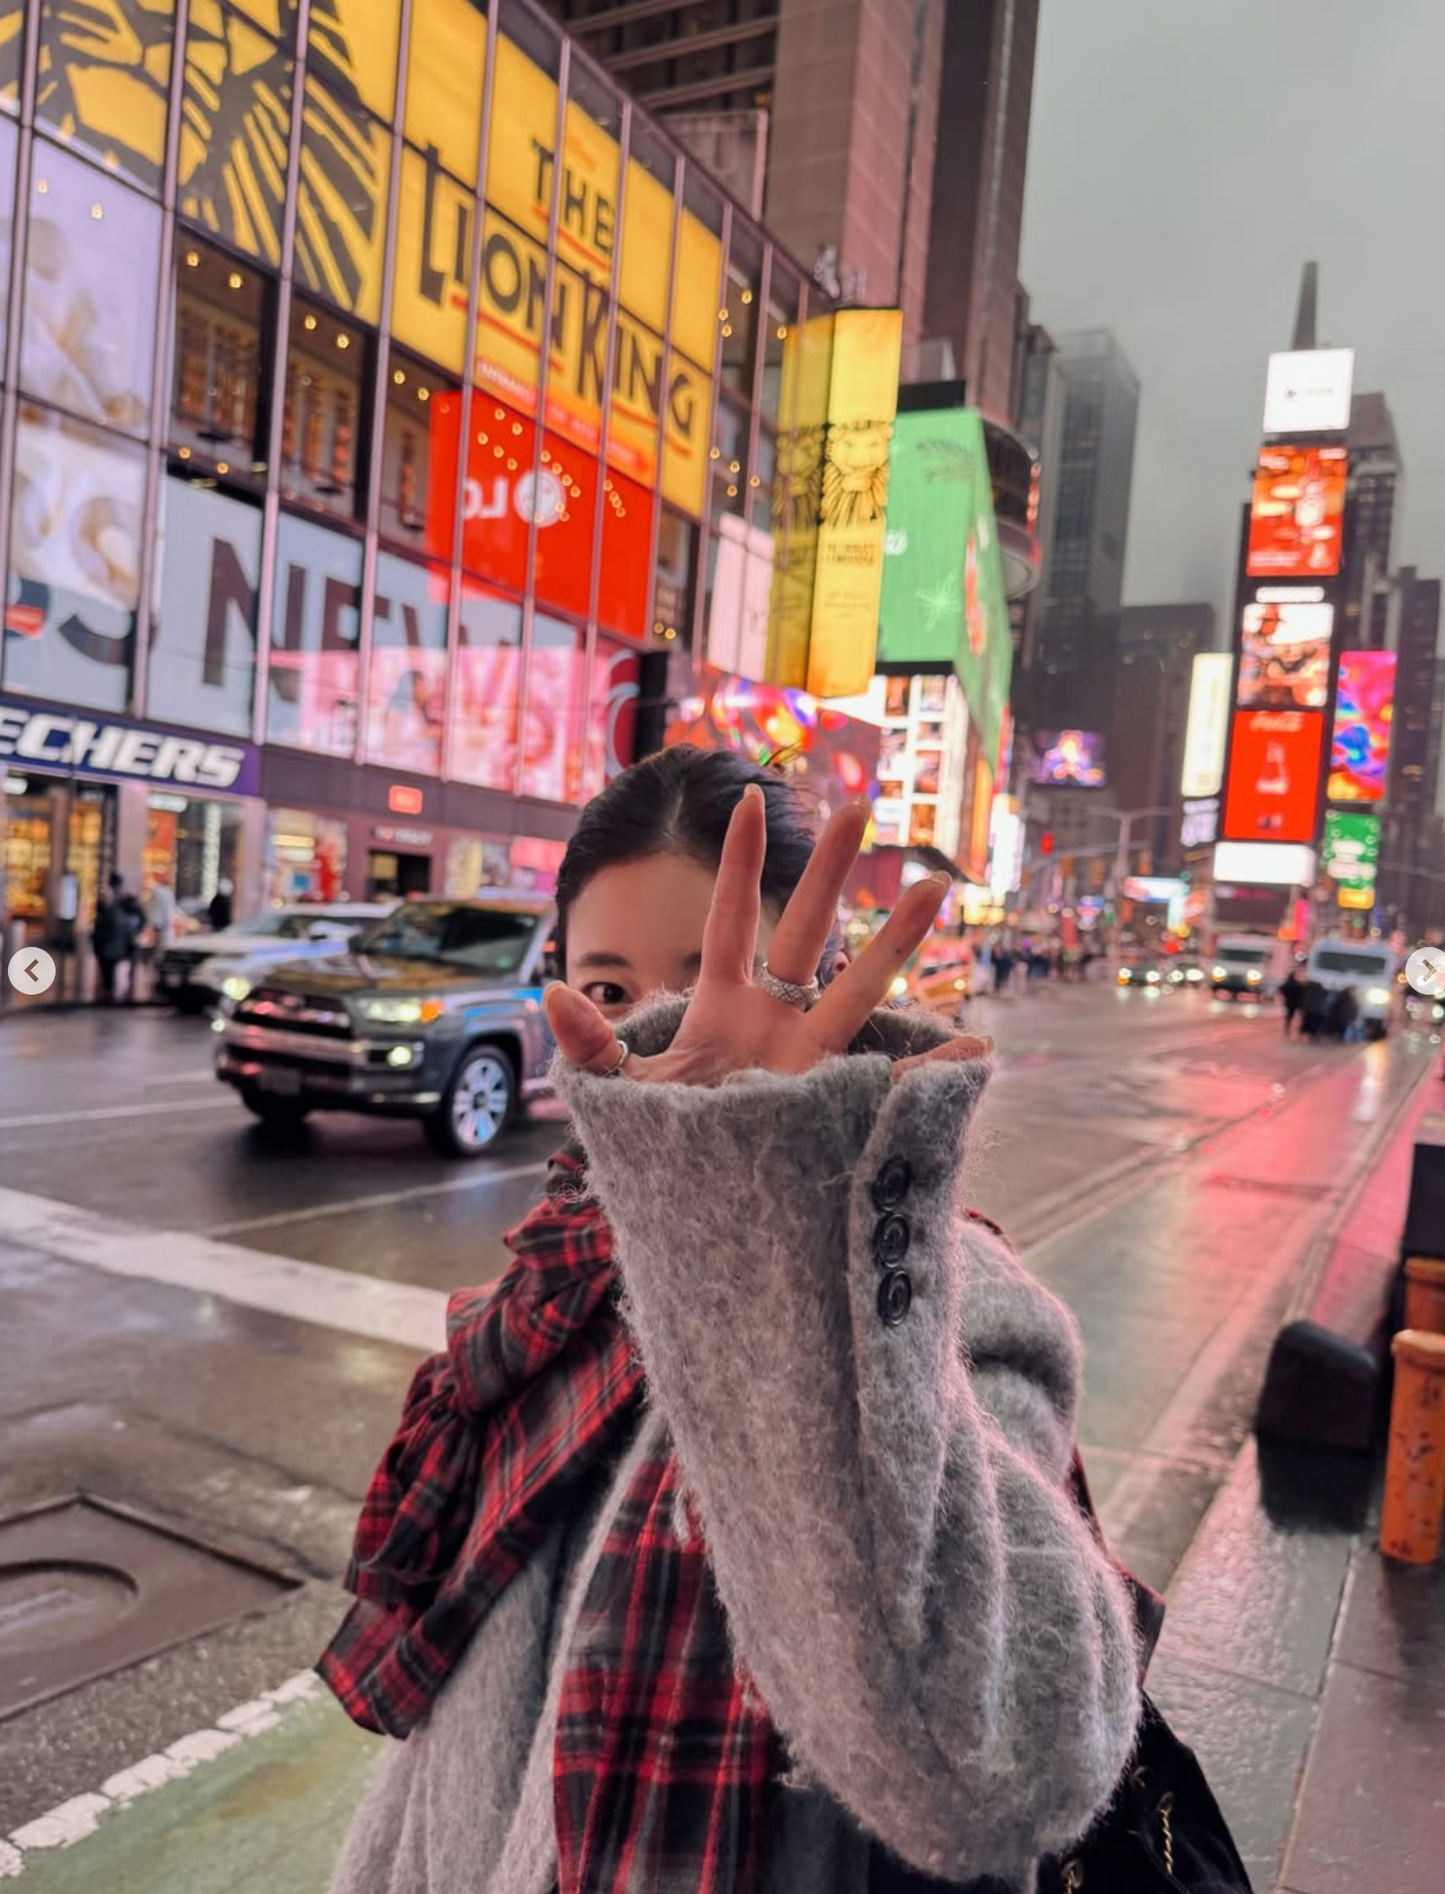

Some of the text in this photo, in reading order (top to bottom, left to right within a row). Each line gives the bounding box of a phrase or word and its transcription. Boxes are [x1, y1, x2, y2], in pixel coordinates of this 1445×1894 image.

[418, 142, 694, 435] LION KING
[532, 137, 617, 256] THE
